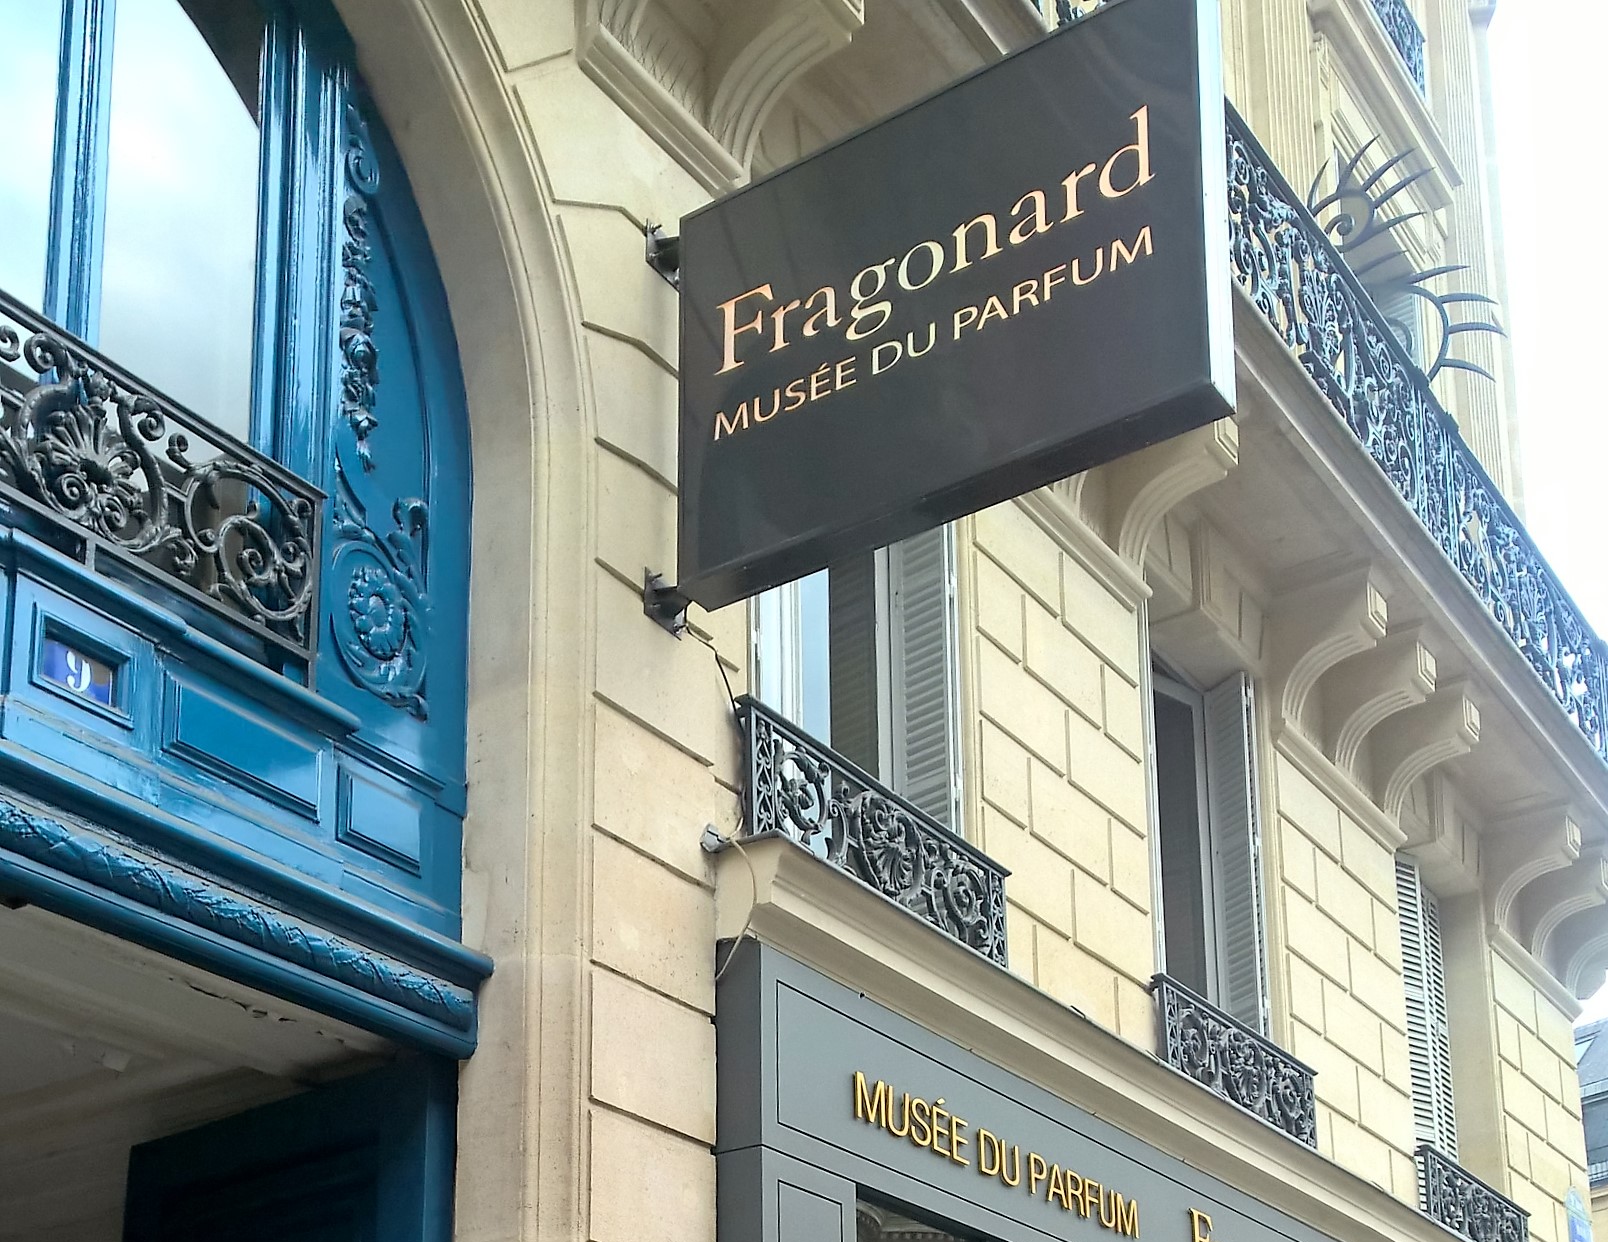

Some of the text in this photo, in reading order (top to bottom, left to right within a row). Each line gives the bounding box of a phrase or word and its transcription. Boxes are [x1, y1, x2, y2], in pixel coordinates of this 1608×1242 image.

[713, 226, 1153, 441] MUSÉE DU PARFUM
[714, 105, 1156, 376] Fragonard
[66, 650, 91, 692] 9
[854, 1071, 970, 1166] MUSÉE
[978, 1128, 1020, 1187] DU
[1029, 1152, 1140, 1239] PARFUM
